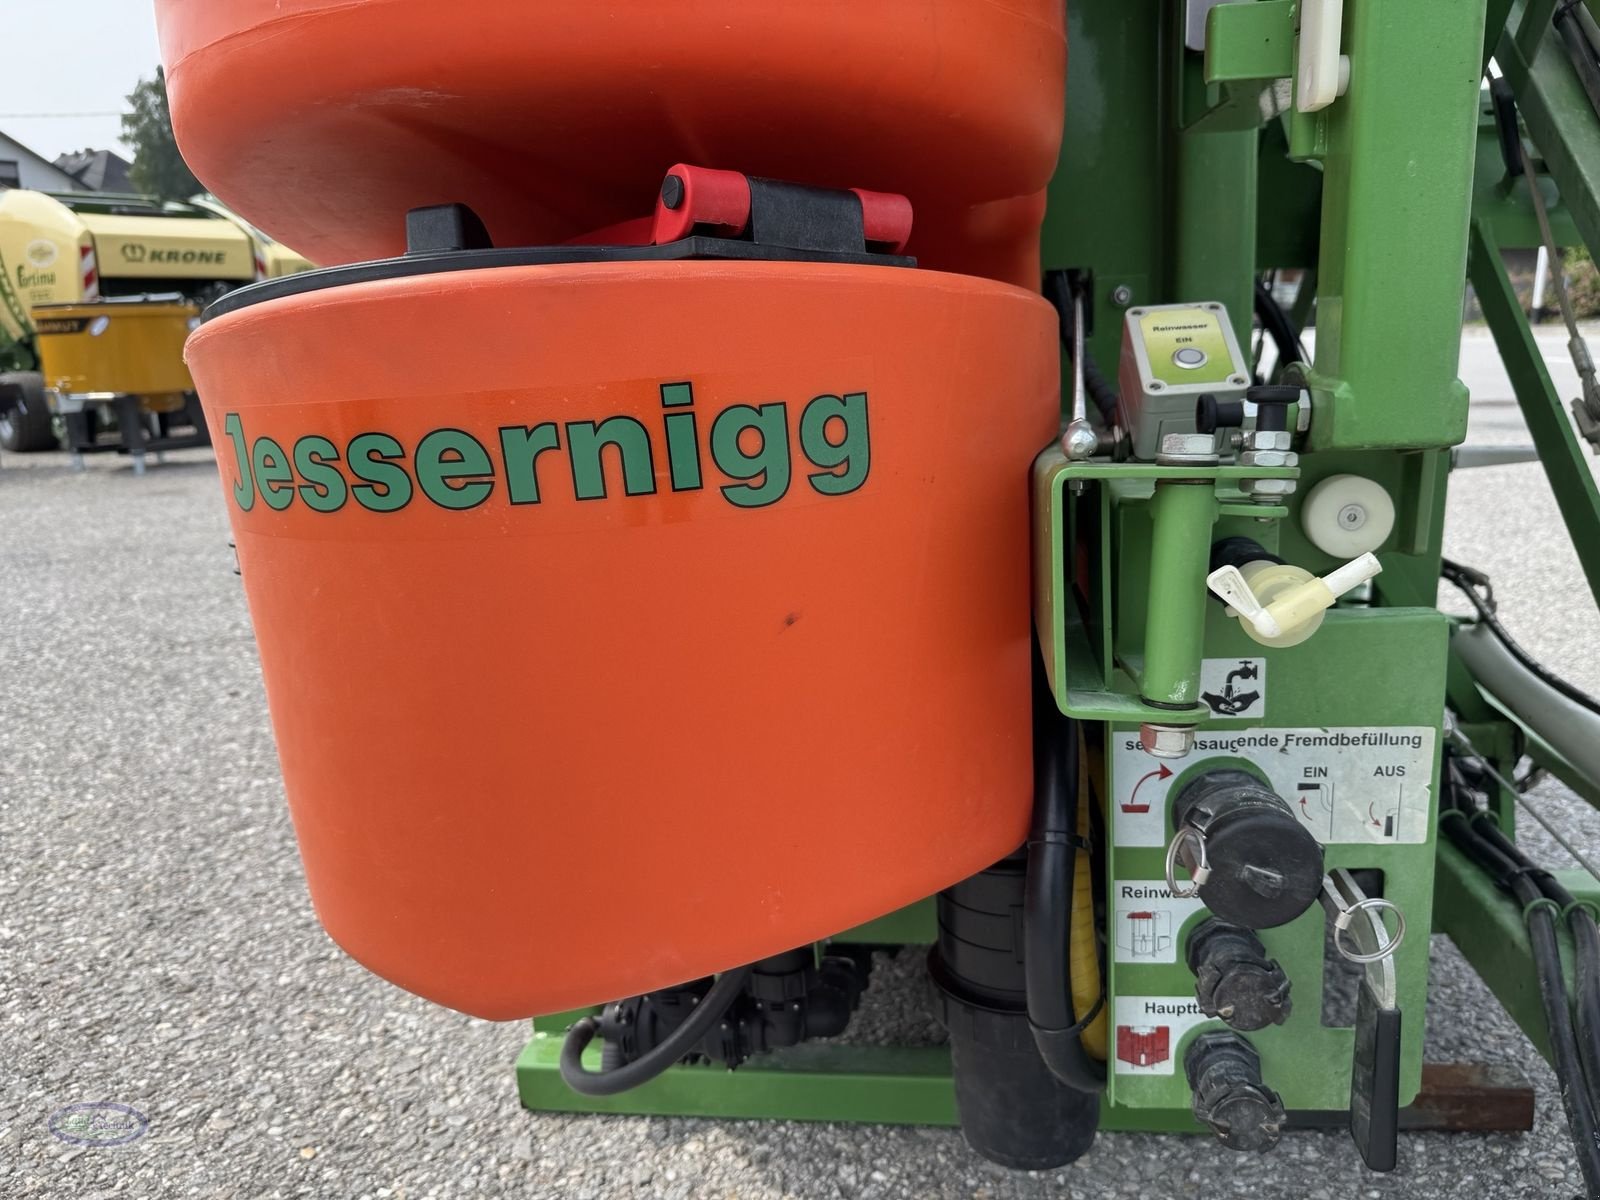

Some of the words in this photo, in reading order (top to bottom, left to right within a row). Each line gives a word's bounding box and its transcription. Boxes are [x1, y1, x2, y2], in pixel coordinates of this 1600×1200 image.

[149, 249, 226, 264] KRONE
[1152, 323, 1208, 332] Reinwasser
[225, 381, 871, 514] Jessernigg
[1285, 731, 1422, 748] Fremdbefüllung
[1303, 766, 1328, 778] EIN
[1374, 765, 1405, 777] AUS
[1144, 1002, 1201, 1016] Hauptt
